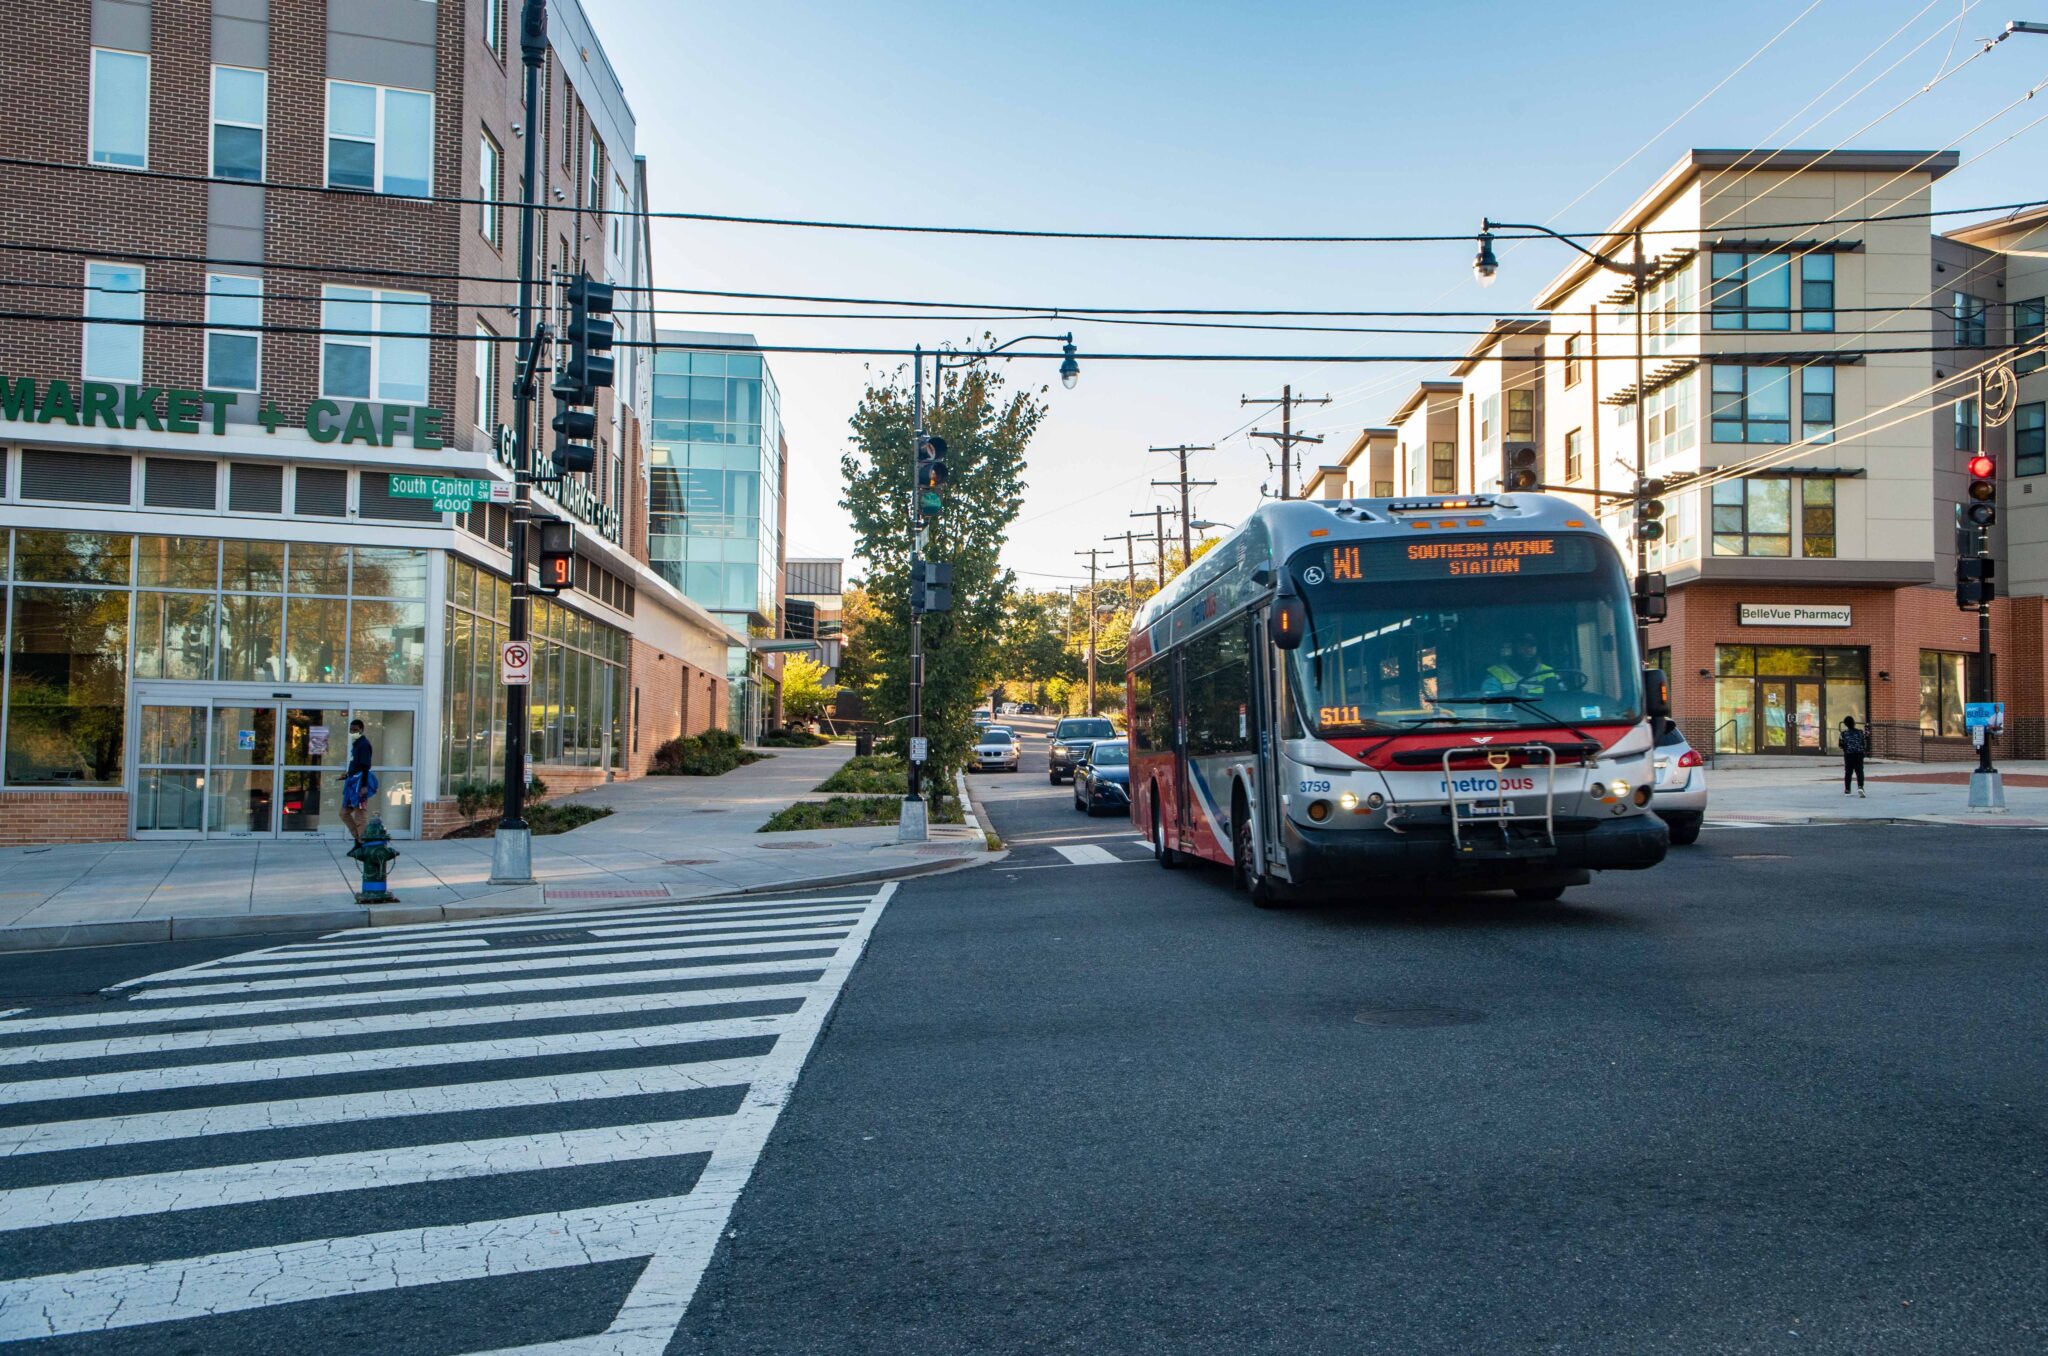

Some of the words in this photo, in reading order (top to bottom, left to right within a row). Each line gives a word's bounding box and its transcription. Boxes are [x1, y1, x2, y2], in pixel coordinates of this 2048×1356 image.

[0, 376, 238, 435] MARKET
[258, 401, 284, 434] +
[306, 400, 443, 450] CAFE
[392, 477, 426, 494] South
[432, 479, 474, 497] Capitol
[479, 481, 488, 490] St
[478, 490, 489, 499] SW
[435, 499, 470, 511] 4000
[562, 475, 597, 526] MARKET
[602, 504, 620, 545] CAFE
[1408, 543, 1489, 559] SOUTHERN
[1492, 540, 1554, 556] AVENUE
[555, 559, 566, 583] 9
[1333, 547, 1363, 579] W1
[1450, 558, 1520, 575] STATION
[1742, 608, 1791, 619] BelleVue
[1794, 609, 1850, 622] Pharmacy
[1320, 706, 1361, 725] S111
[1300, 780, 1331, 792] 3759
